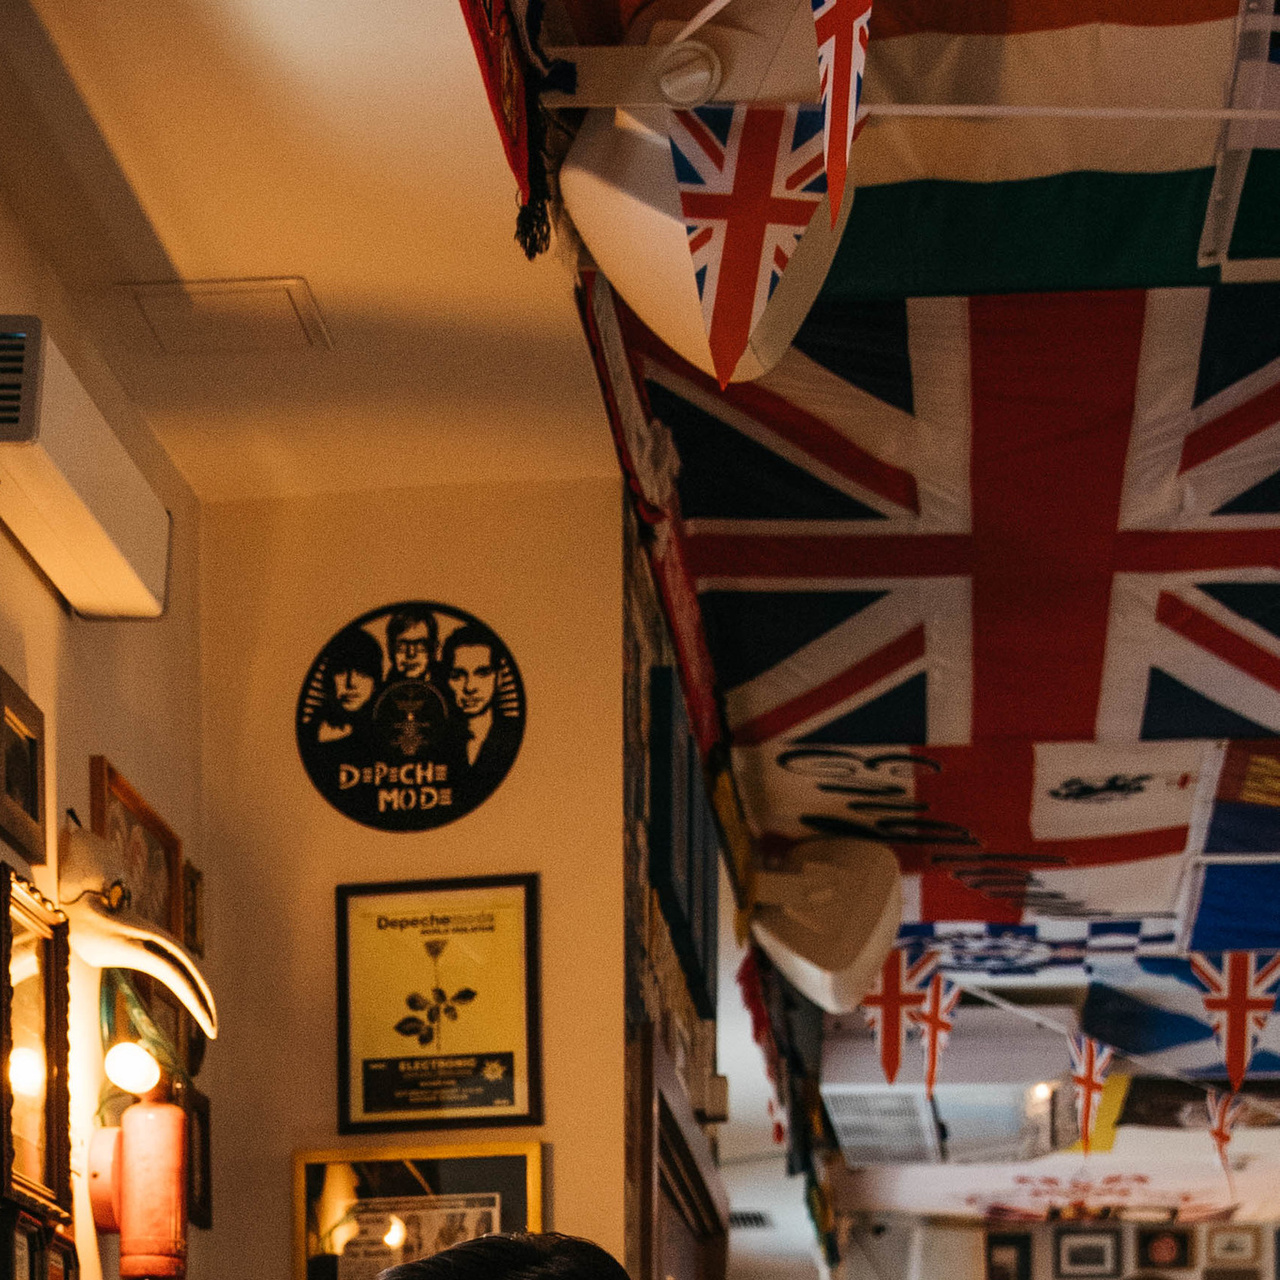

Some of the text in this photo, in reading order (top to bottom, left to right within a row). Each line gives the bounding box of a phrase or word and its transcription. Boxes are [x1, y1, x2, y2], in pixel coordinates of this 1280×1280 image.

[339, 761, 448, 790] DEPECHE
[378, 786, 453, 813] MODE
[376, 913, 451, 931] Depeche
